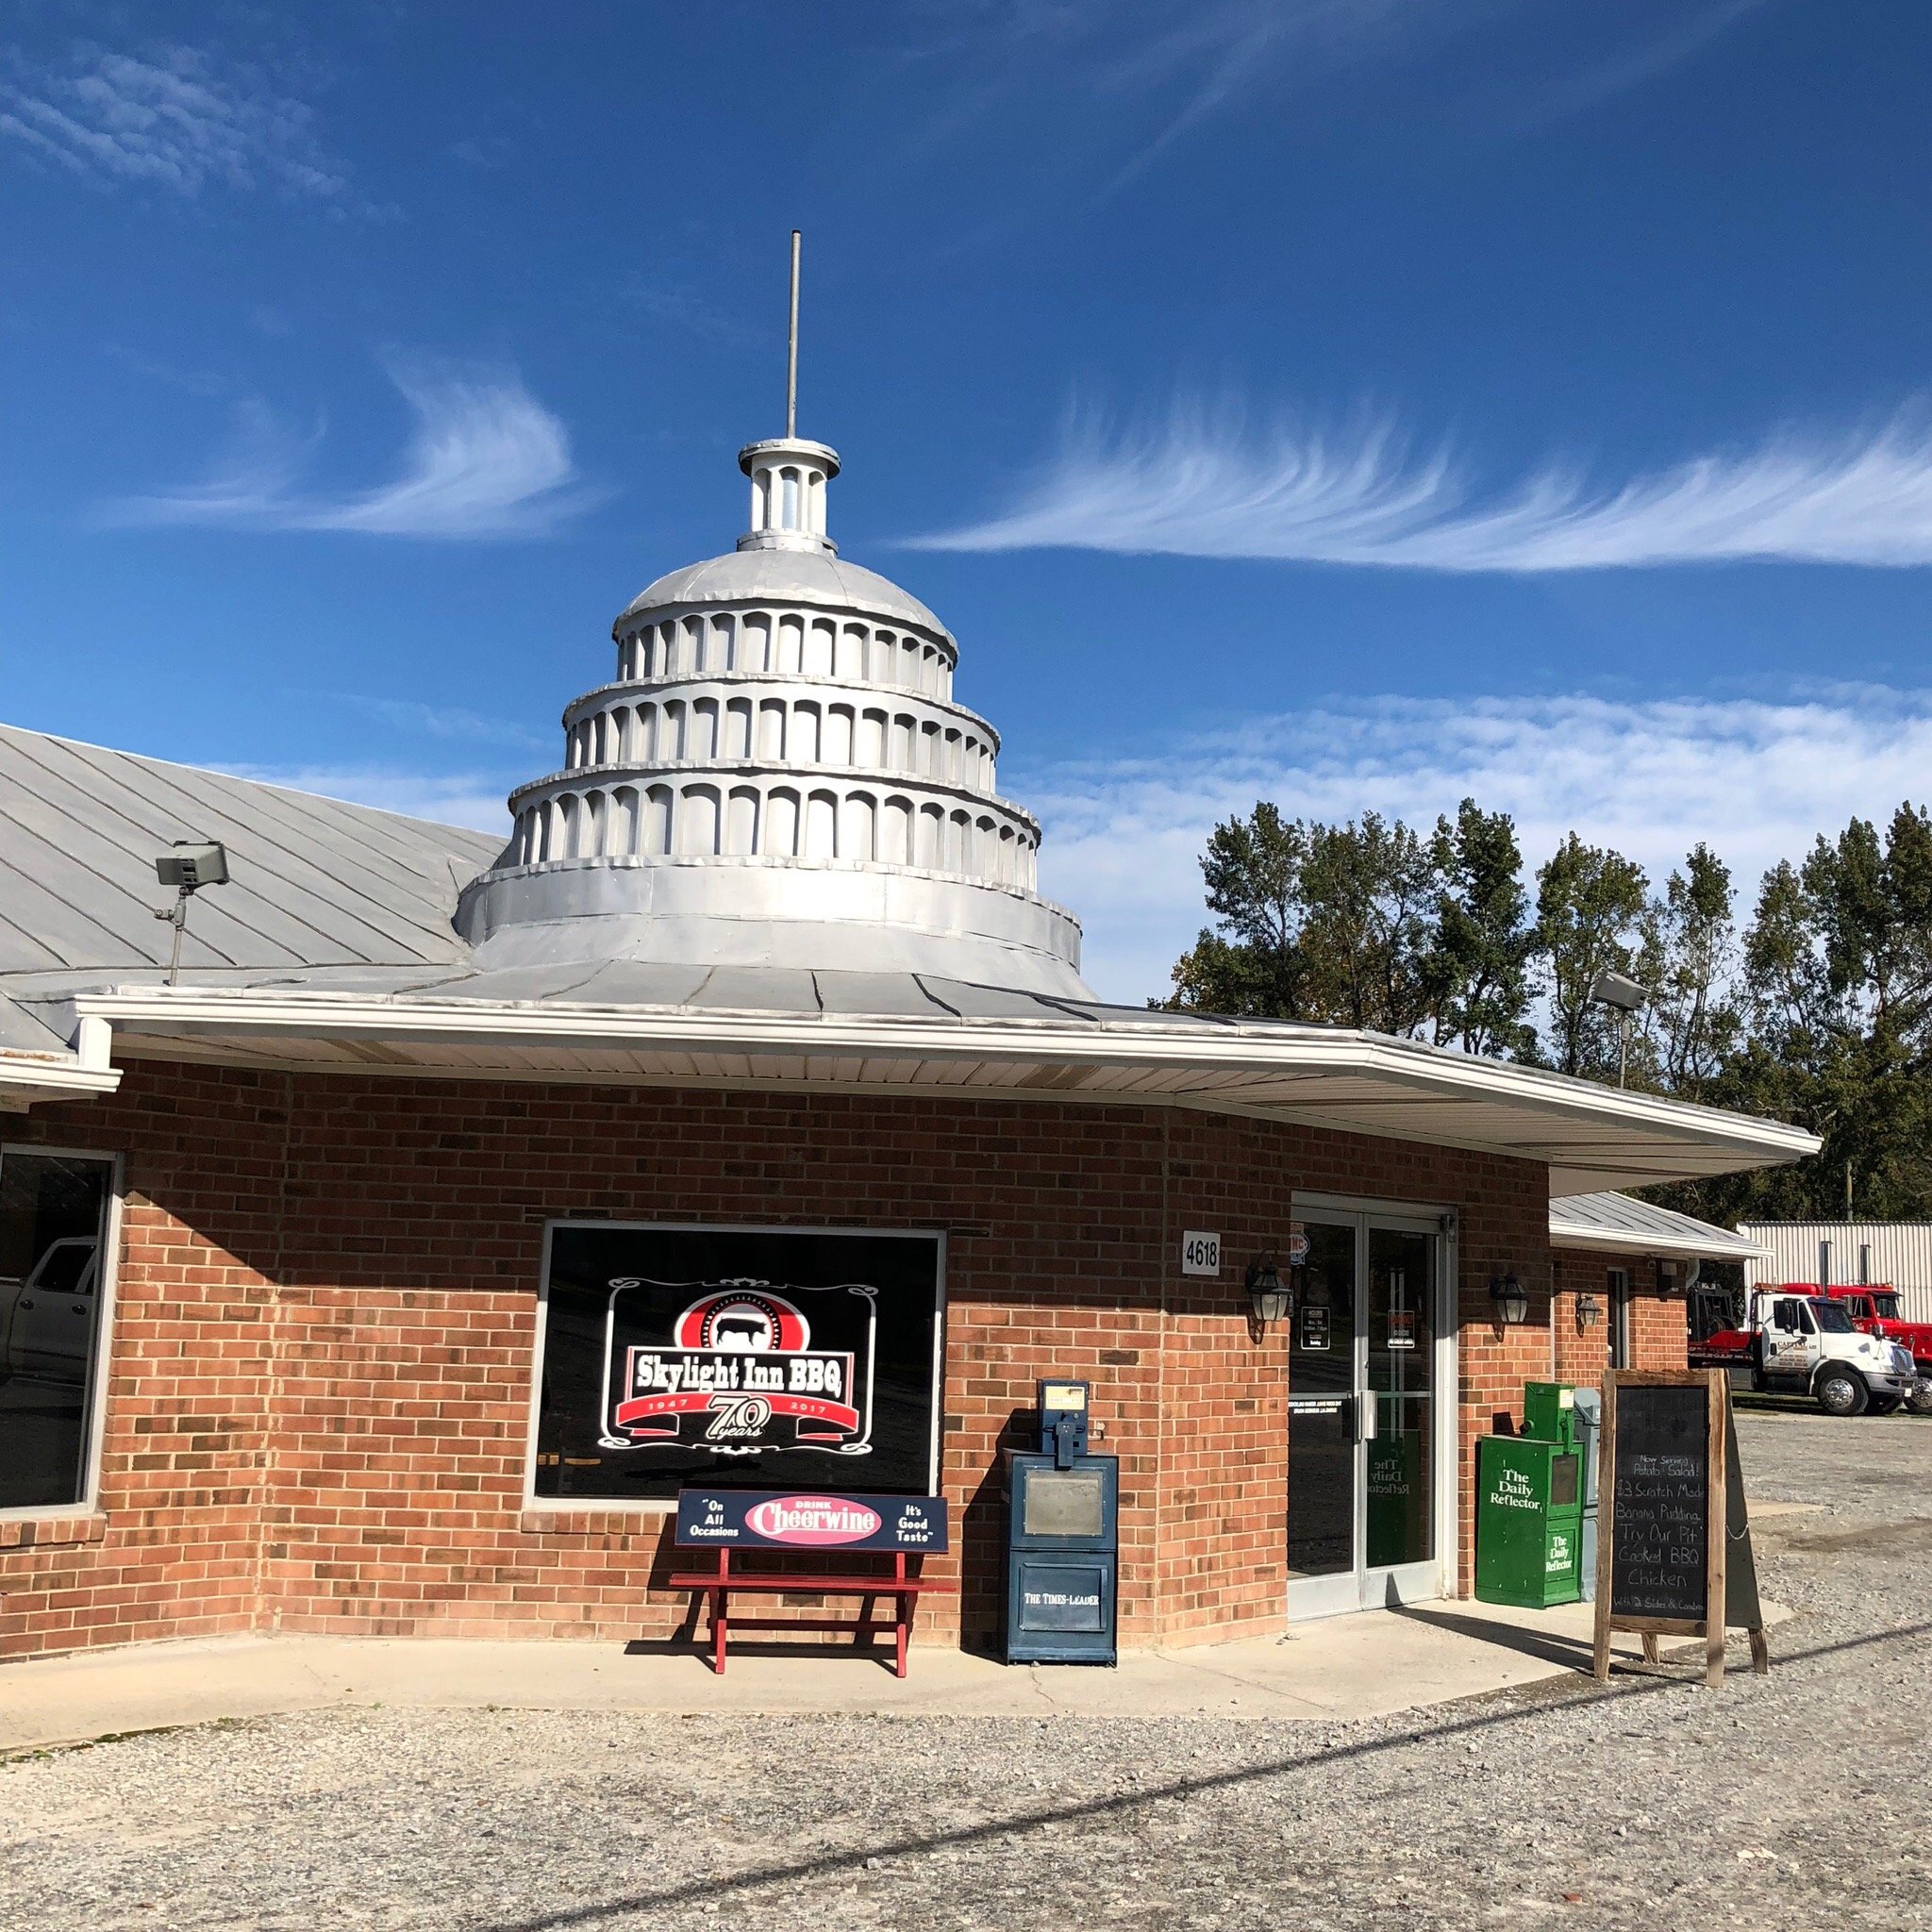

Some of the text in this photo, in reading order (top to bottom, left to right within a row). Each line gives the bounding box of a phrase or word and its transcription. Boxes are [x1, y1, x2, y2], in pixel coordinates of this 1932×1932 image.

[1186, 1240, 1217, 1267] 4618
[637, 1354, 842, 1399] Skylight Inn BBQ
[648, 1399, 689, 1410] 1947
[790, 1402, 826, 1414] 2017
[707, 1394, 772, 1439] 70
[717, 1427, 764, 1440] years
[1640, 1455, 1689, 1467] Now Serving
[1503, 1468, 1530, 1484] The
[1633, 1463, 1660, 1477] Potato
[1498, 1480, 1534, 1498] Daily
[1635, 1482, 1674, 1498] Scratch
[794, 1500, 832, 1509] DRINK
[1490, 1491, 1541, 1510] Reflector
[906, 1504, 922, 1516] It's
[1615, 1501, 1655, 1520] Banana
[705, 1513, 724, 1525] All
[753, 1502, 875, 1535] Cheerwine
[898, 1516, 928, 1530] Good
[690, 1524, 739, 1537] Occasions
[1619, 1523, 1698, 1547] Try Our Pit
[1552, 1536, 1568, 1548] The
[1550, 1546, 1569, 1559] Daily
[1618, 1545, 1699, 1565] Cooked BBQ
[1545, 1559, 1573, 1573] Reflector
[1627, 1568, 1687, 1588] Chicken
[1024, 1592, 1099, 1606] THE TIMES-LEADER
